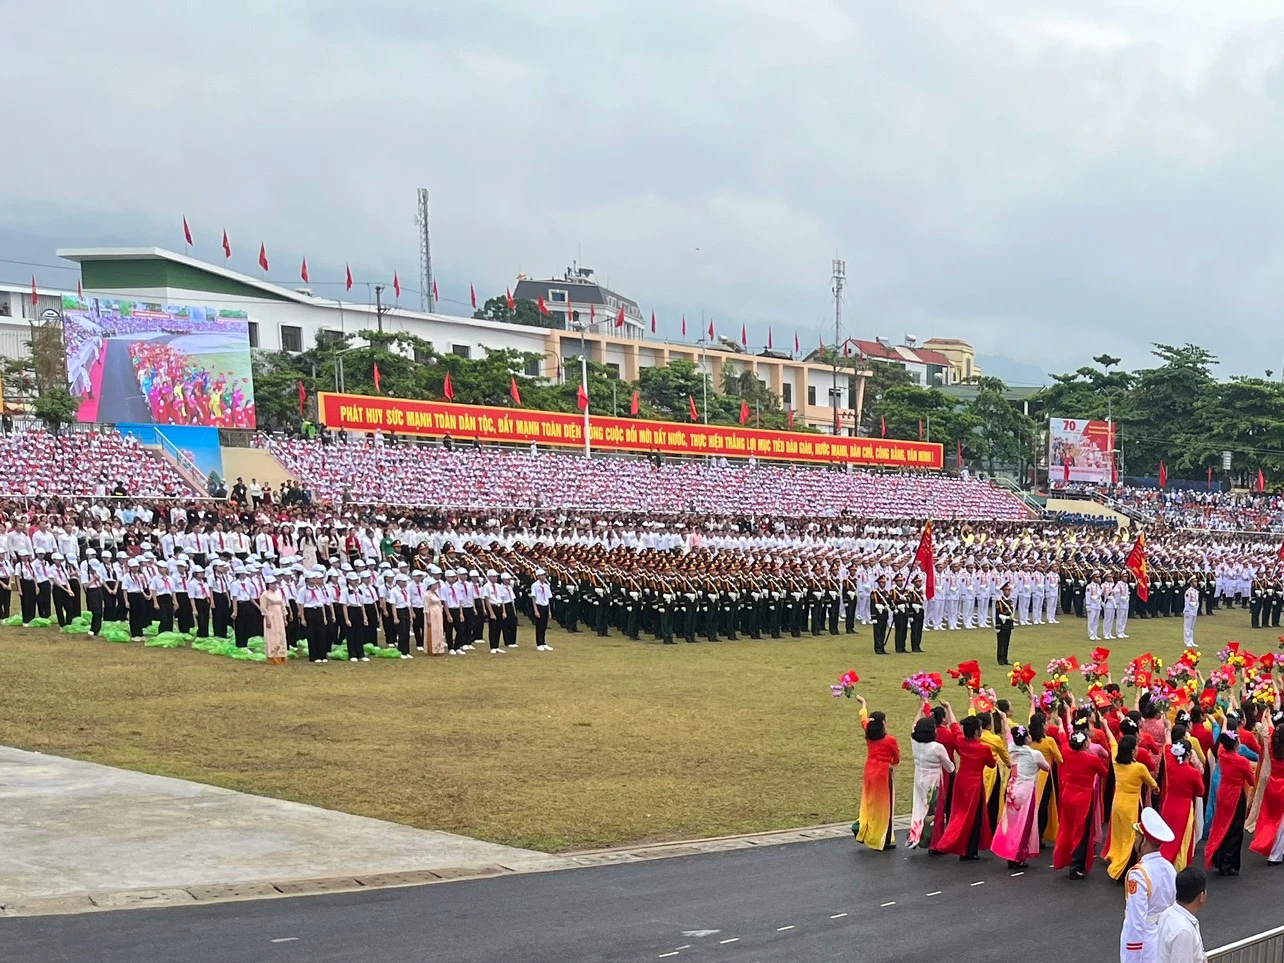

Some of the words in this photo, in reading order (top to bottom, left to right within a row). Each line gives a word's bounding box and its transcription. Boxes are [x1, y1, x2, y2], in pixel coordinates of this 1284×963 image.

[340, 404, 363, 423] PHÁT
[366, 408, 383, 424] HUY
[386, 407, 404, 426] SỨC
[406, 411, 432, 430] MẠNH
[434, 411, 456, 429] TOÀN
[459, 413, 476, 431] DÂN
[478, 414, 496, 435] TỘC,
[498, 413, 514, 433] ĐẨY
[516, 420, 540, 438] MẠNH
[541, 420, 561, 437] TOÀN
[564, 421, 581, 441] DIỆN
[584, 423, 604, 440] ÔNG
[605, 425, 624, 444] CUỘC
[654, 427, 667, 444] ĐẤT
[690, 433, 707, 450] THỰC
[708, 433, 724, 451] HIỆN
[1063, 420, 1076, 431] 70
